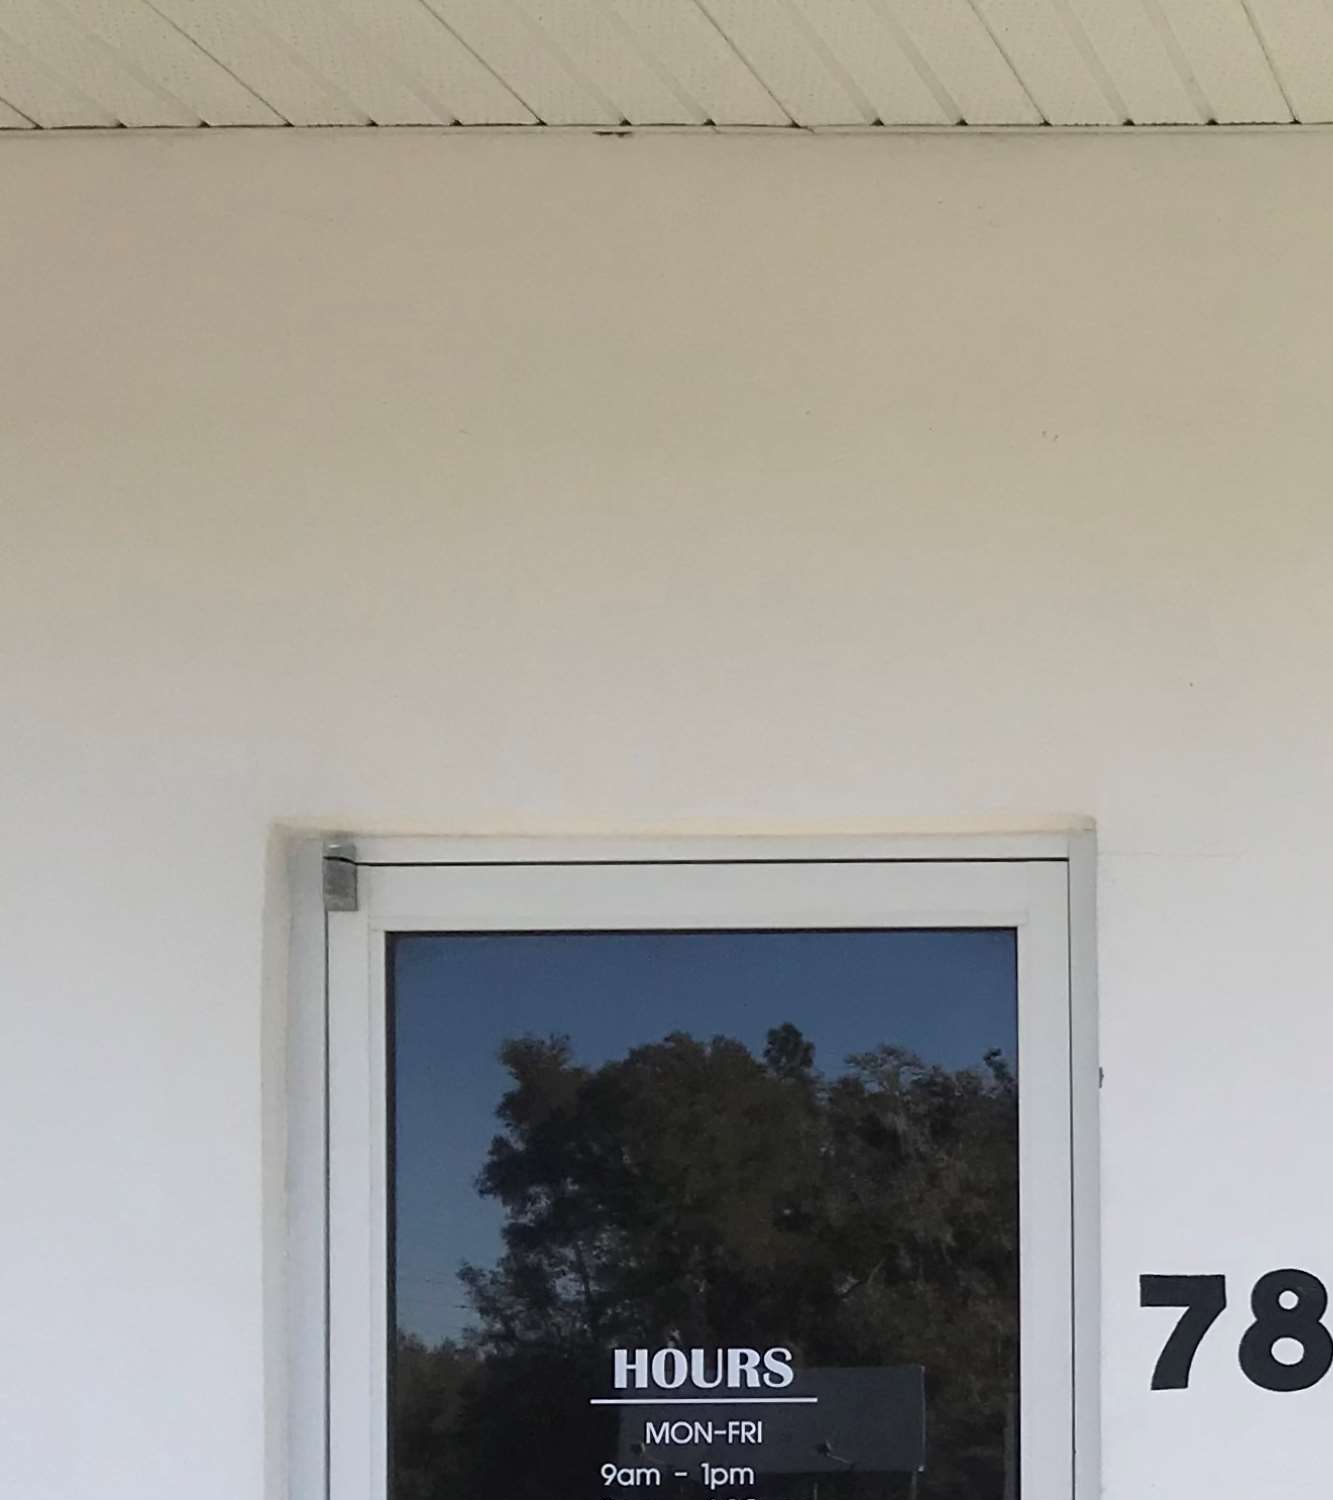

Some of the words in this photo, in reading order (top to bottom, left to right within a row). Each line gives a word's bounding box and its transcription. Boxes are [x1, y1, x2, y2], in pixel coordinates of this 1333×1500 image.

[614, 1347, 794, 1389] HOURS
[646, 1421, 762, 1444] MON-FRI
[600, 1463, 661, 1486] 9am
[701, 1462, 754, 1490] 1pm
